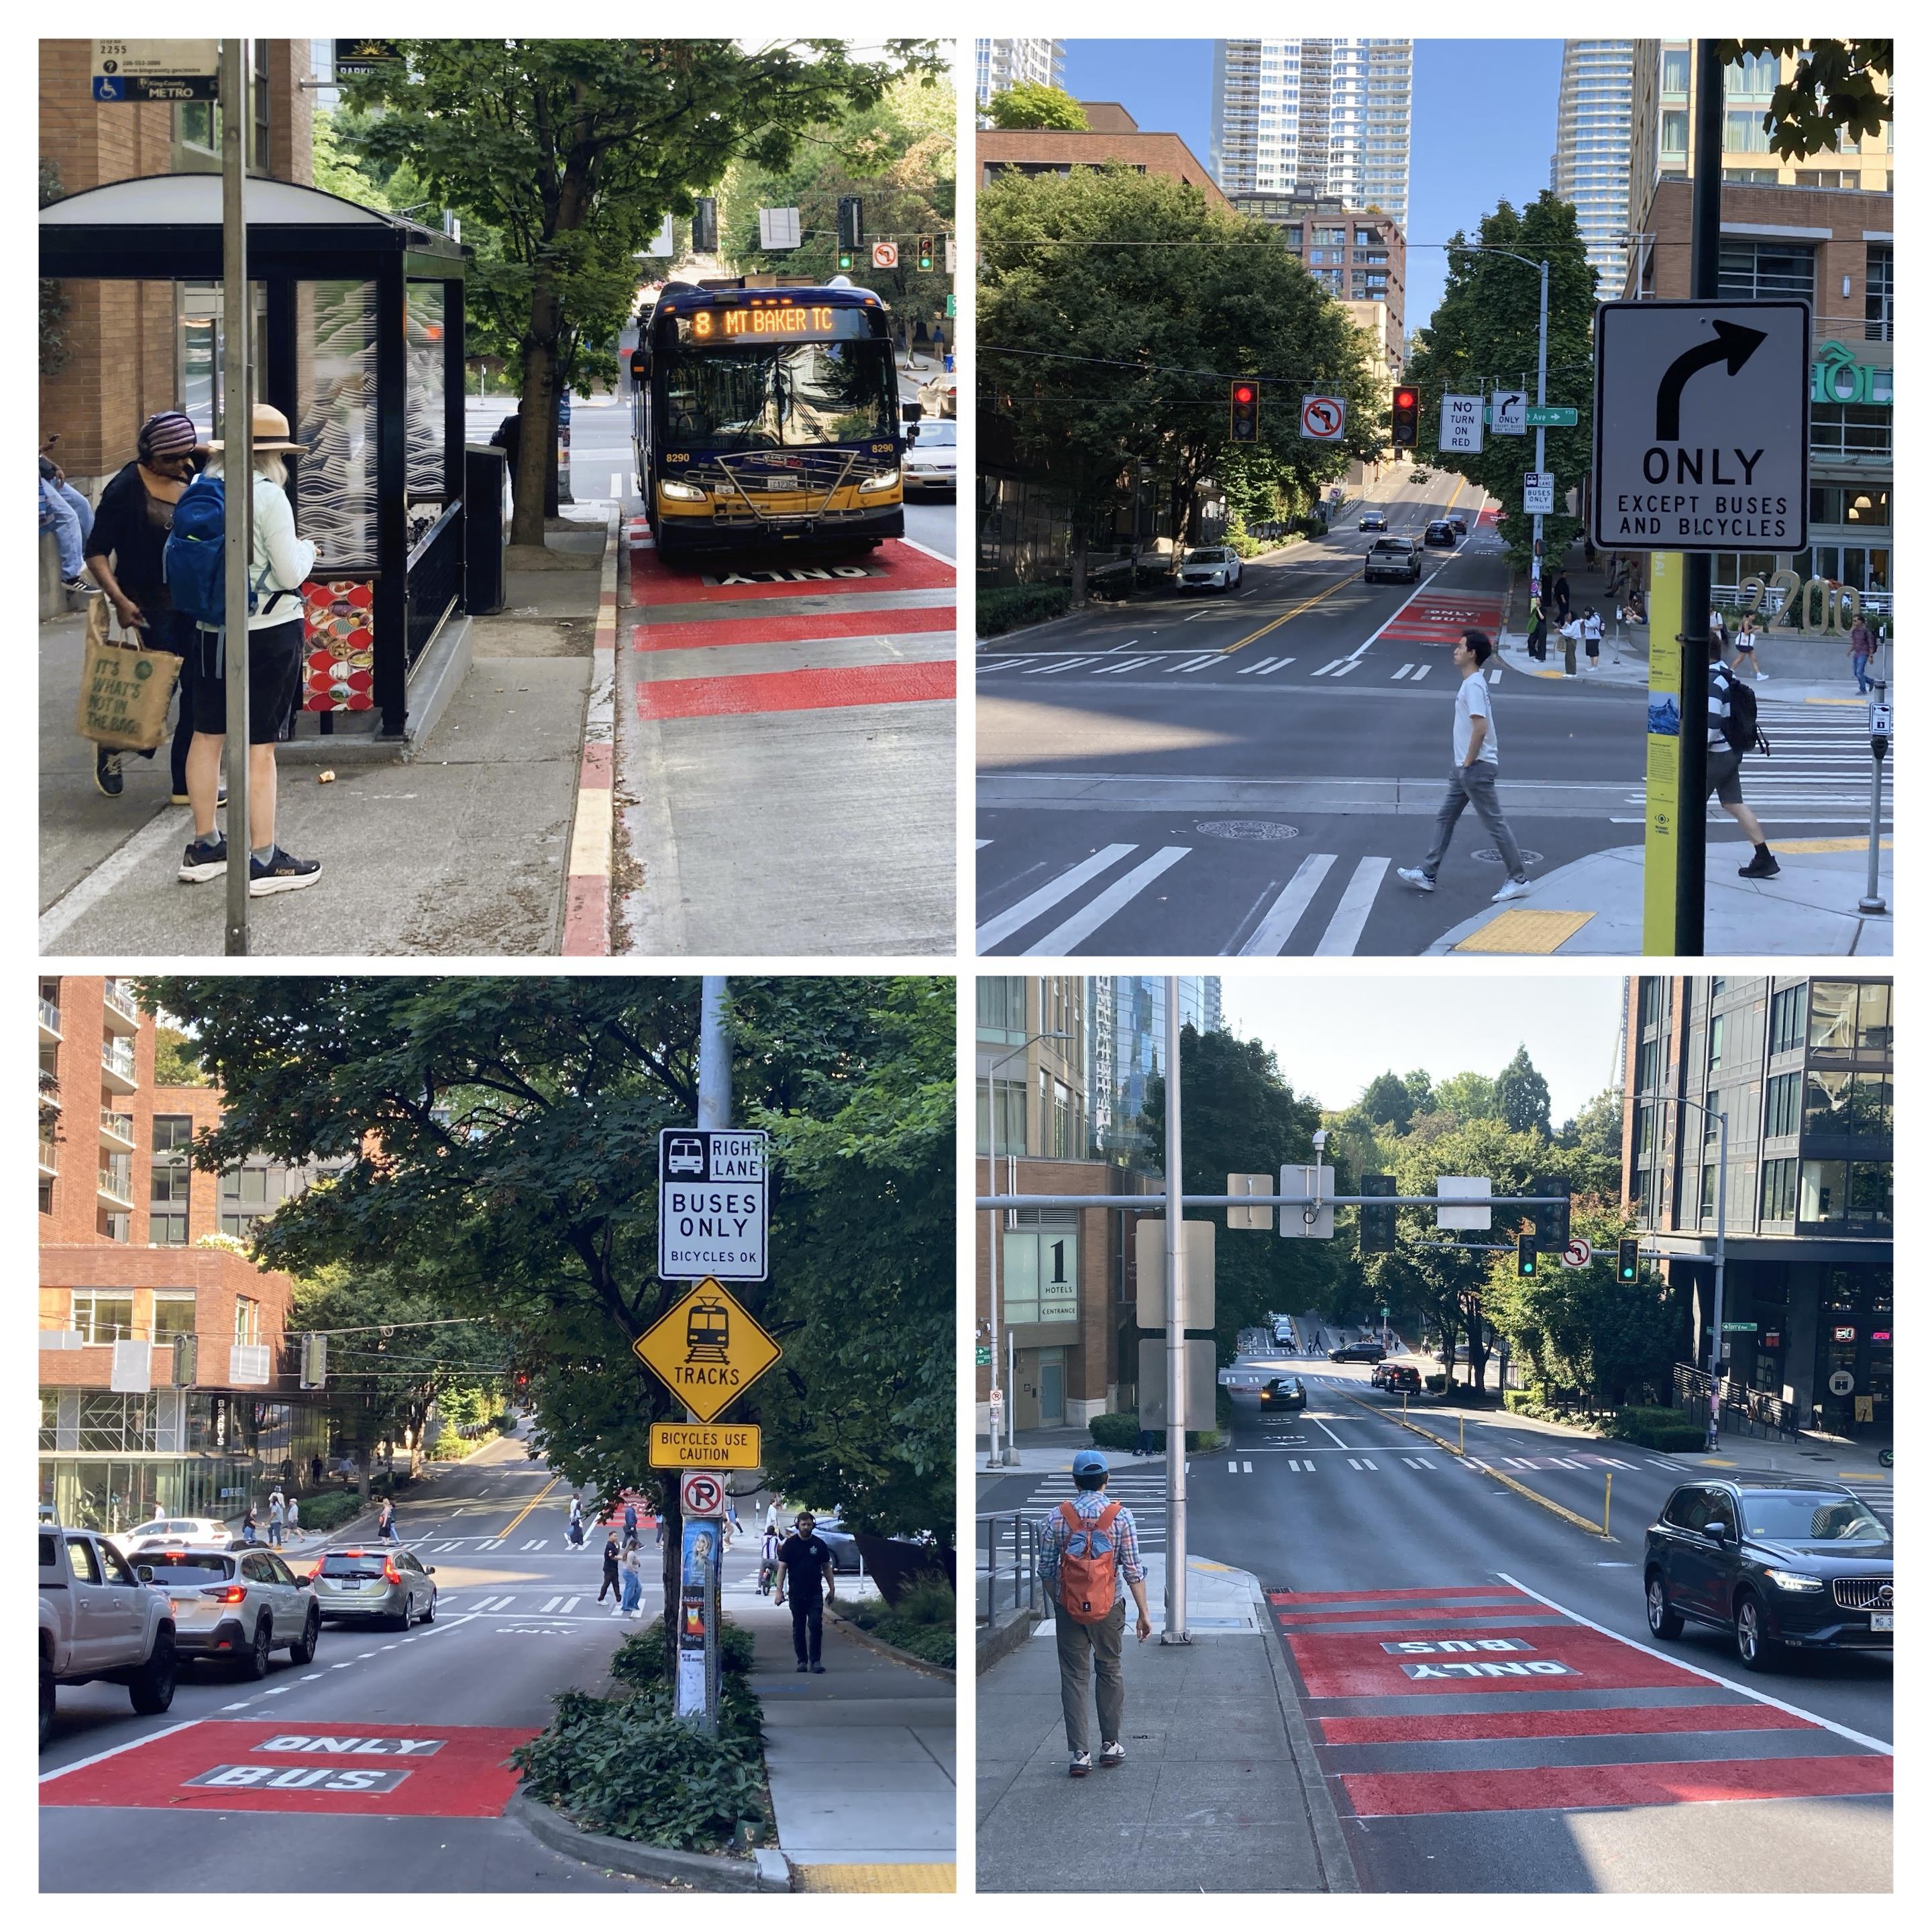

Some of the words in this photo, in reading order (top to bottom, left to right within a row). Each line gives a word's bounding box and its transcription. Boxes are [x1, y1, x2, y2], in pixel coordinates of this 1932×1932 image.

[100, 45, 127, 54] 2255
[148, 88, 194, 98] METRO
[696, 312, 710, 335] 8
[726, 311, 748, 333] MT
[753, 308, 807, 333] BAKER
[811, 307, 833, 331] TC
[1452, 401, 1472, 413] NO
[1450, 415, 1474, 424] TURN
[1499, 416, 1519, 424] ONLY
[1532, 413, 1546, 422] Ave
[1454, 427, 1467, 435] ON
[871, 443, 894, 453] 8290
[1452, 438, 1470, 447] RED
[666, 453, 690, 462] 8290
[1643, 447, 1765, 486] ONLY
[1618, 494, 1699, 513] EXCEPT
[1715, 496, 1787, 515] BUSES
[1619, 517, 1661, 535] AND
[1678, 518, 1786, 537] BICYCLES
[722, 566, 868, 585] ONLY
[1737, 569, 1861, 637] 2200
[96, 658, 120, 676] IT'S
[91, 676, 141, 698] WHAT'S
[88, 694, 113, 712] NOT
[113, 700, 128, 714] IN
[715, 1160, 759, 1176] LANE
[672, 1193, 756, 1214] BUSES
[680, 1217, 749, 1238] ONLY
[671, 1250, 735, 1262] BICYCLES
[740, 1252, 757, 1263] OK
[1051, 1239, 1068, 1283] 1
[1045, 1286, 1073, 1294] HOTELS
[1046, 1307, 1076, 1316] ENTRANCE
[674, 1366, 740, 1385] TRACKS
[661, 1432, 718, 1446] BICYCLES
[725, 1434, 748, 1446] USE
[679, 1447, 729, 1460] CAUTION
[1875, 1617, 1884, 1626] MG
[1397, 1639, 1519, 1654] BUS
[1413, 1662, 1567, 1678] ONLY
[262, 1736, 441, 1755] ONLY
[204, 1766, 388, 1790] BUS
